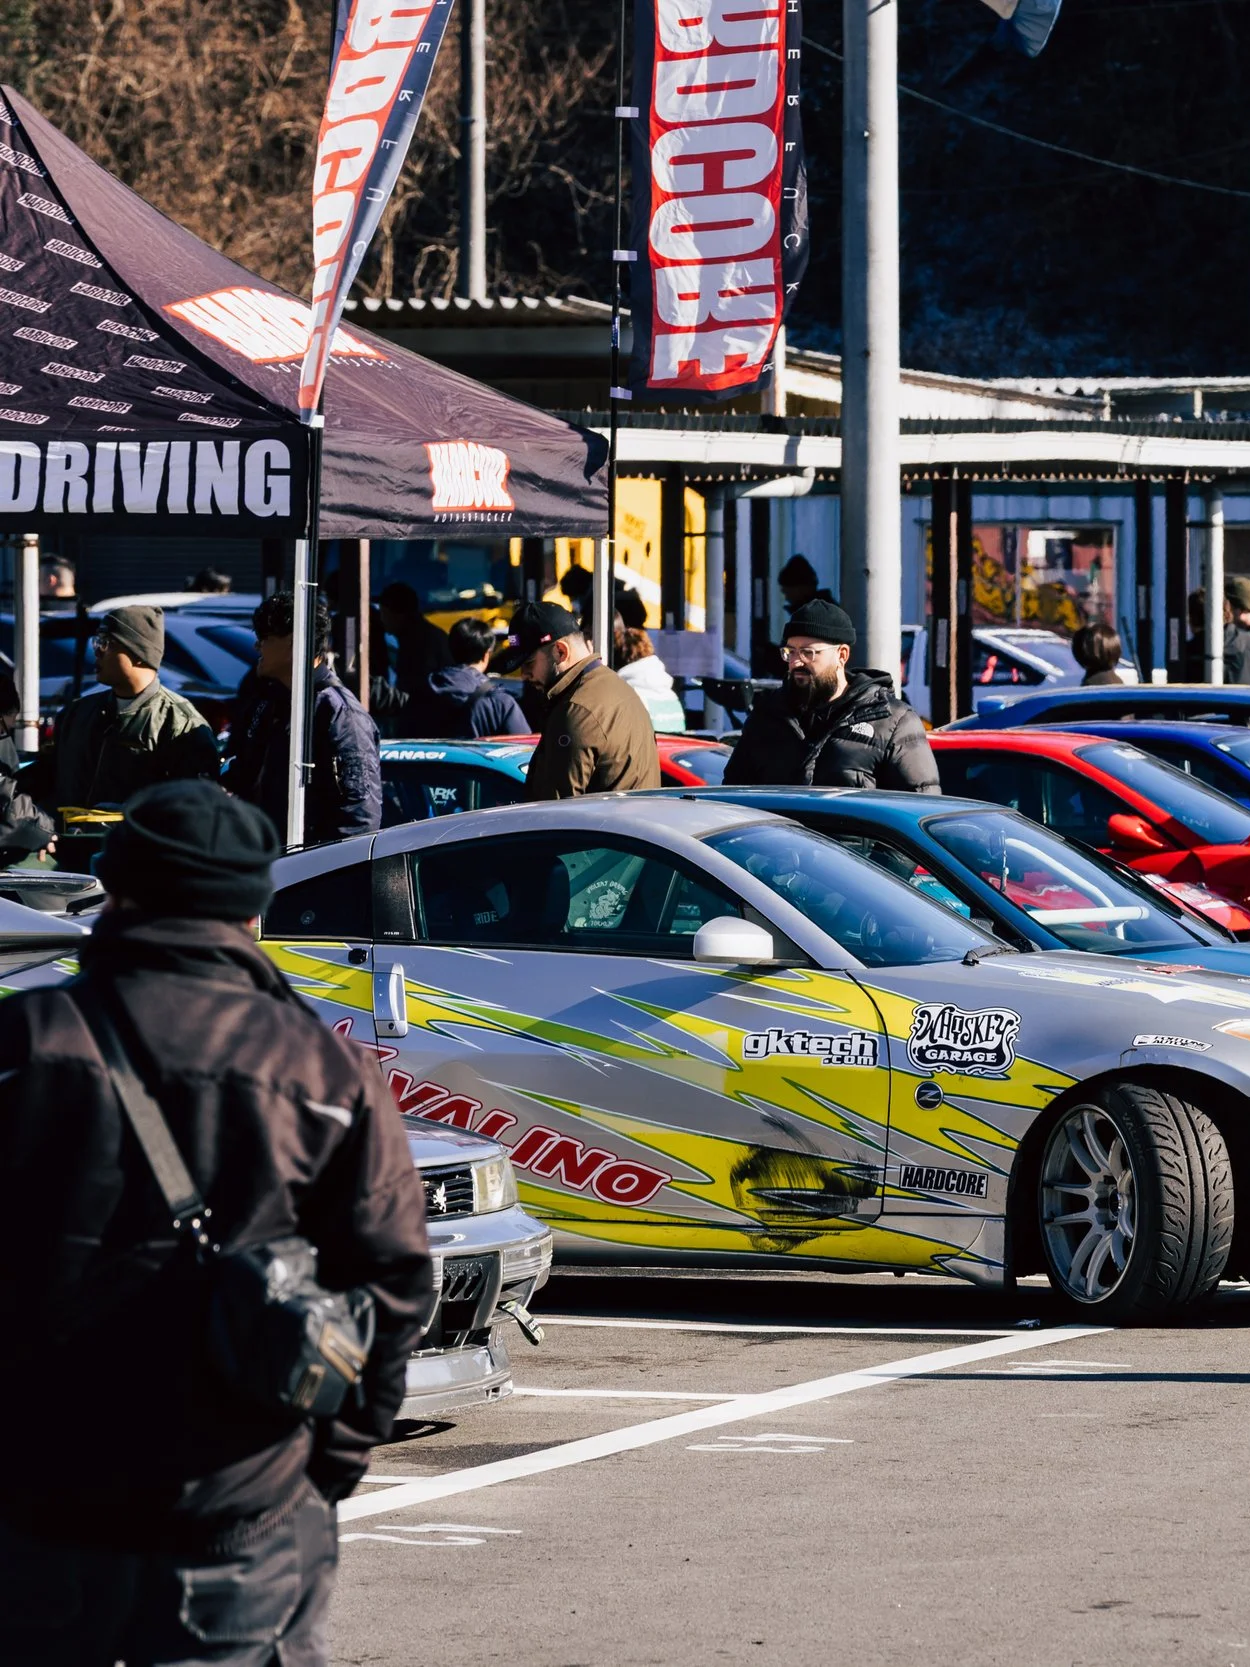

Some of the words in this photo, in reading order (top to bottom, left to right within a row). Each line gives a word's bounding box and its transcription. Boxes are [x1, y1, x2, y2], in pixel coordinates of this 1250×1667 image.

[0, 439, 290, 517] DRIVING
[915, 1006, 1015, 1046] WHISKEY
[744, 1030, 877, 1058] gktech
[925, 1049, 997, 1063] GARAGE
[823, 1055, 875, 1065] .com
[387, 1068, 673, 1206] VALINO
[902, 1166, 986, 1196] HARDCORE
